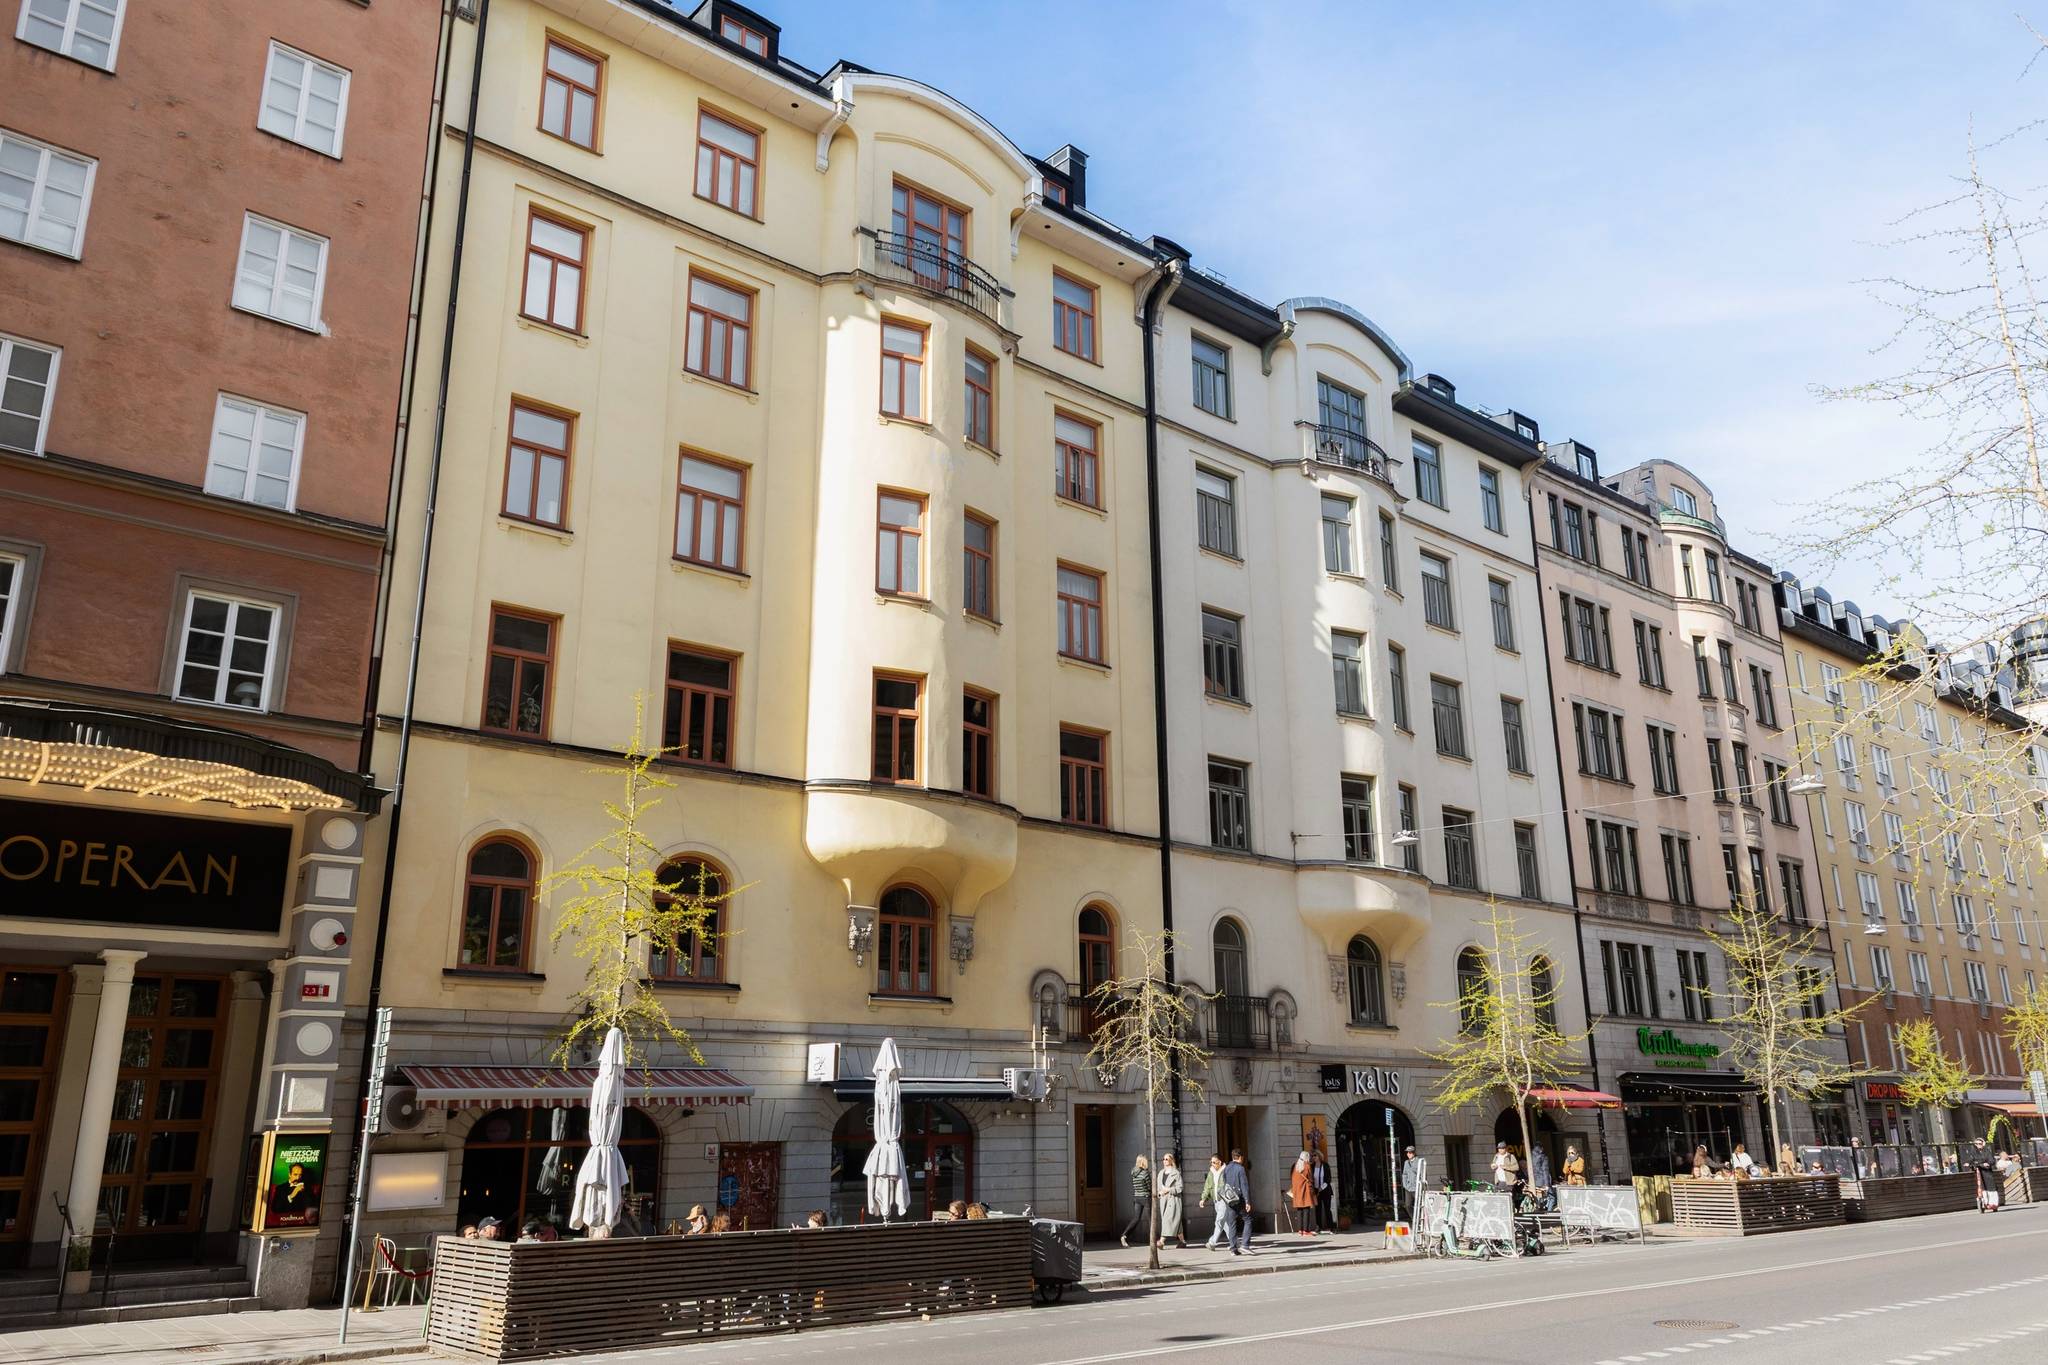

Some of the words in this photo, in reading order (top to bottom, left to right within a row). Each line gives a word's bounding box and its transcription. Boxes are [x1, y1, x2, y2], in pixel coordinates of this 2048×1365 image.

[0, 834, 238, 896] OPERAN
[1353, 1066, 1400, 1095] K&US
[1867, 1083, 1888, 1098] DROP
[1889, 1084, 1898, 1098] IN
[280, 1149, 321, 1158] NIETZSCHE
